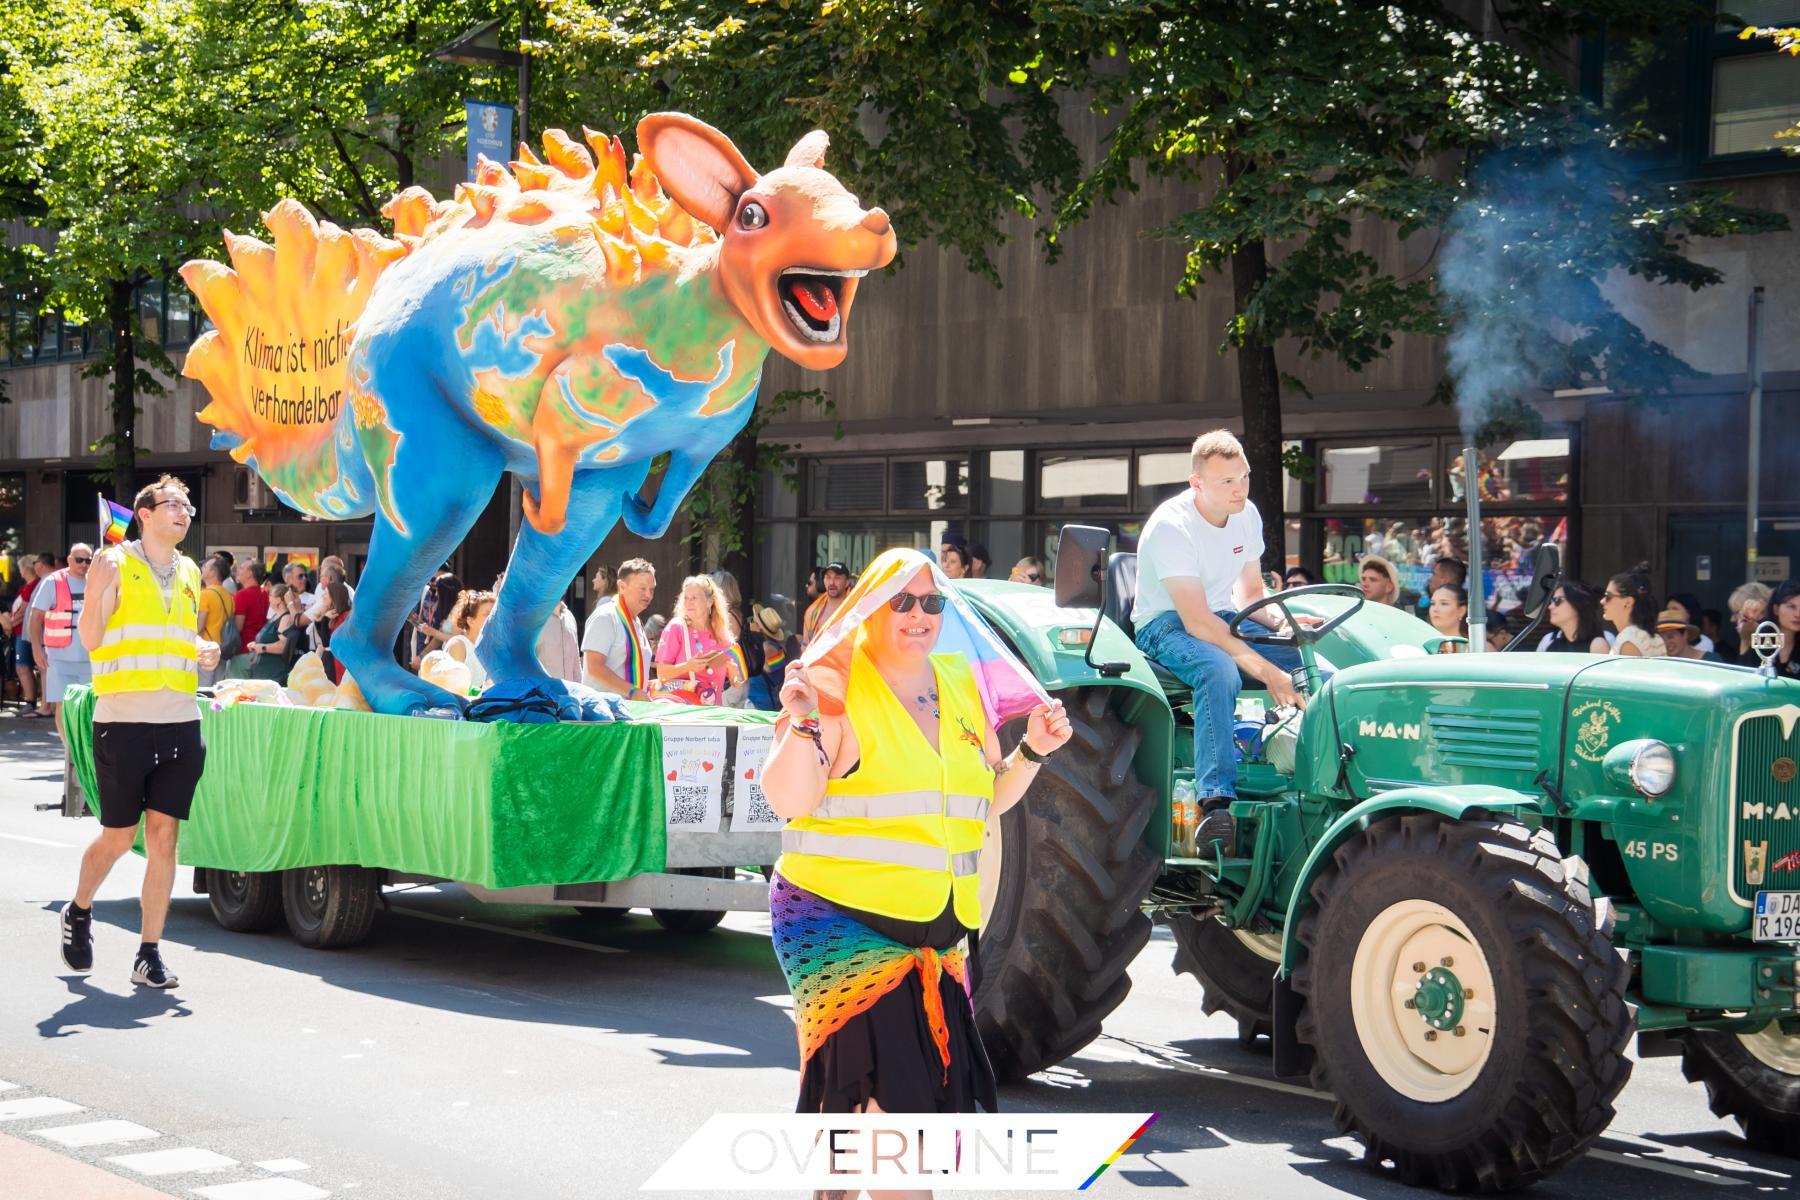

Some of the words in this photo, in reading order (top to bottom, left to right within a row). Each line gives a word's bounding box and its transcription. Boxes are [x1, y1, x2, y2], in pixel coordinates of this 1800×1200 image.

[244, 325, 283, 374] Klima
[286, 332, 307, 374] ist
[251, 383, 342, 426] verhandelbar
[1624, 840, 1647, 859] 45
[1652, 842, 1679, 862] PS
[1759, 917, 1769, 938] R
